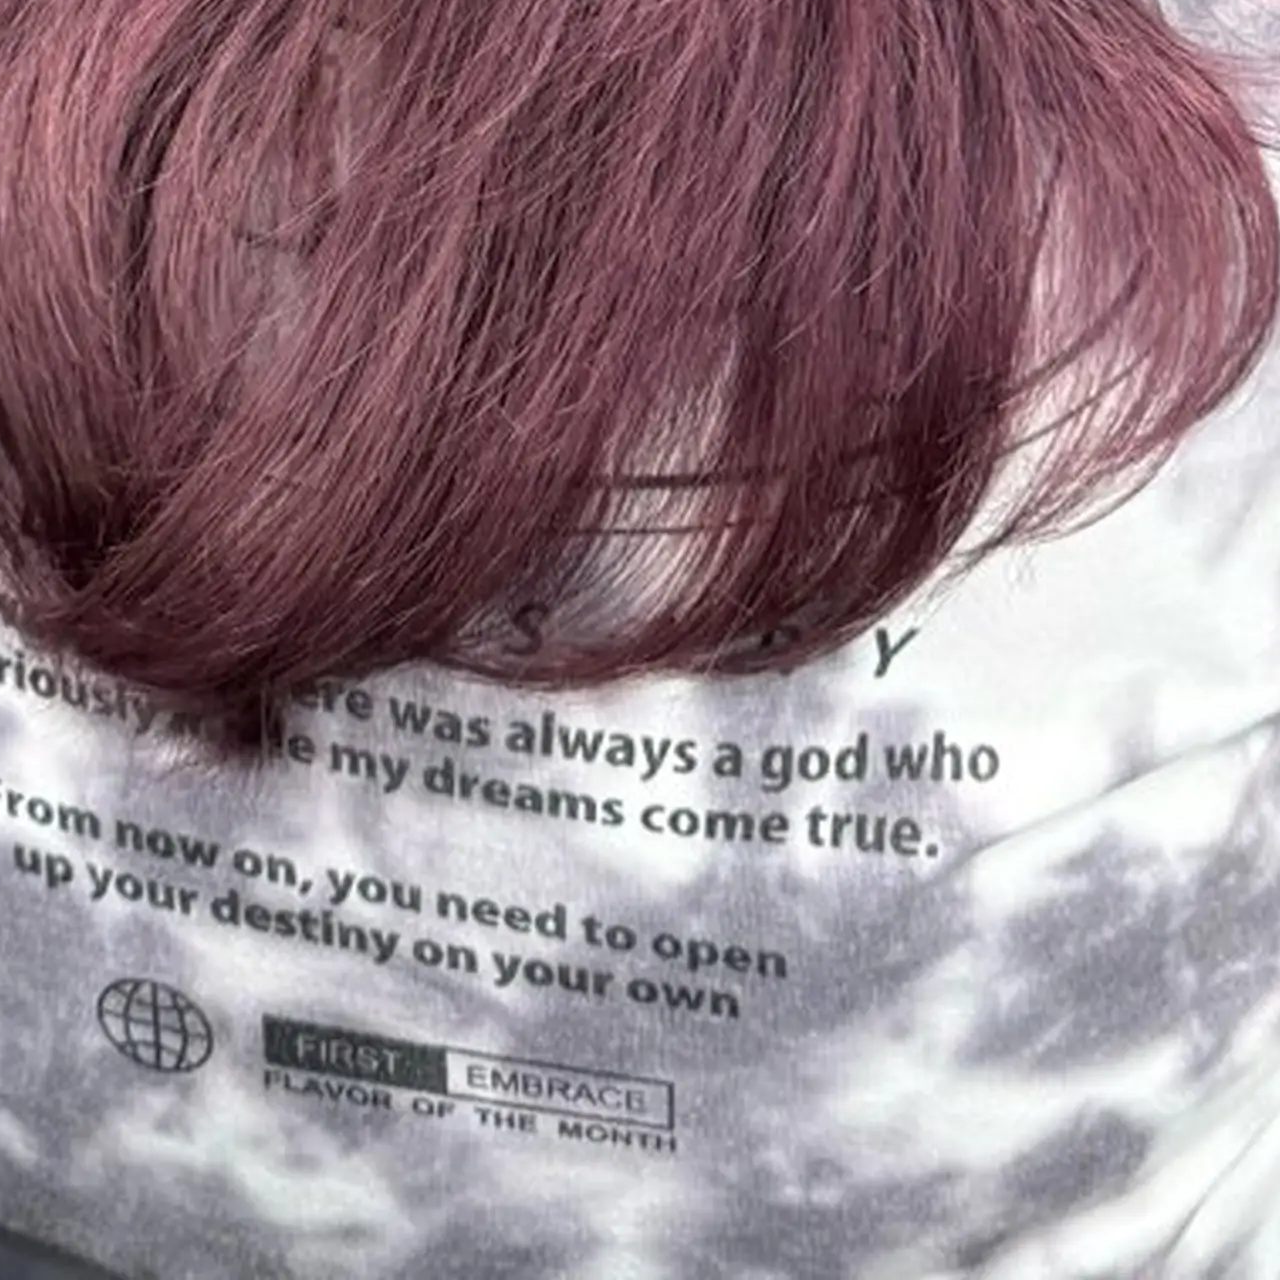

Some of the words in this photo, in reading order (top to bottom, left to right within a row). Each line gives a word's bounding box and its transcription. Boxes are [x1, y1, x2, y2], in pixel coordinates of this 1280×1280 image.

[389, 695, 490, 747] was
[506, 711, 698, 781] always
[712, 741, 743, 778] a
[761, 732, 869, 793] god
[885, 730, 1000, 783] who
[330, 741, 409, 794] my
[423, 758, 625, 827] dreams
[641, 803, 790, 844] come
[806, 808, 940, 858] true.
[13, 844, 73, 890] up
[87, 867, 198, 916] your
[210, 890, 400, 966] destiny
[412, 942, 478, 974] on
[491, 953, 613, 1002] your
[626, 978, 741, 1020] own
[115, 818, 219, 869] now
[232, 850, 313, 896] on,
[327, 867, 421, 916] you
[436, 888, 566, 940] need
[582, 914, 637, 954] to
[651, 926, 788, 980] open
[262, 1068, 392, 1112] FLAVOR
[412, 1097, 457, 1120] OF
[474, 1106, 539, 1134] THE
[557, 1121, 678, 1154] MONTH
[295, 1034, 403, 1078] FIRST
[465, 1063, 649, 1115] EMBRACE
